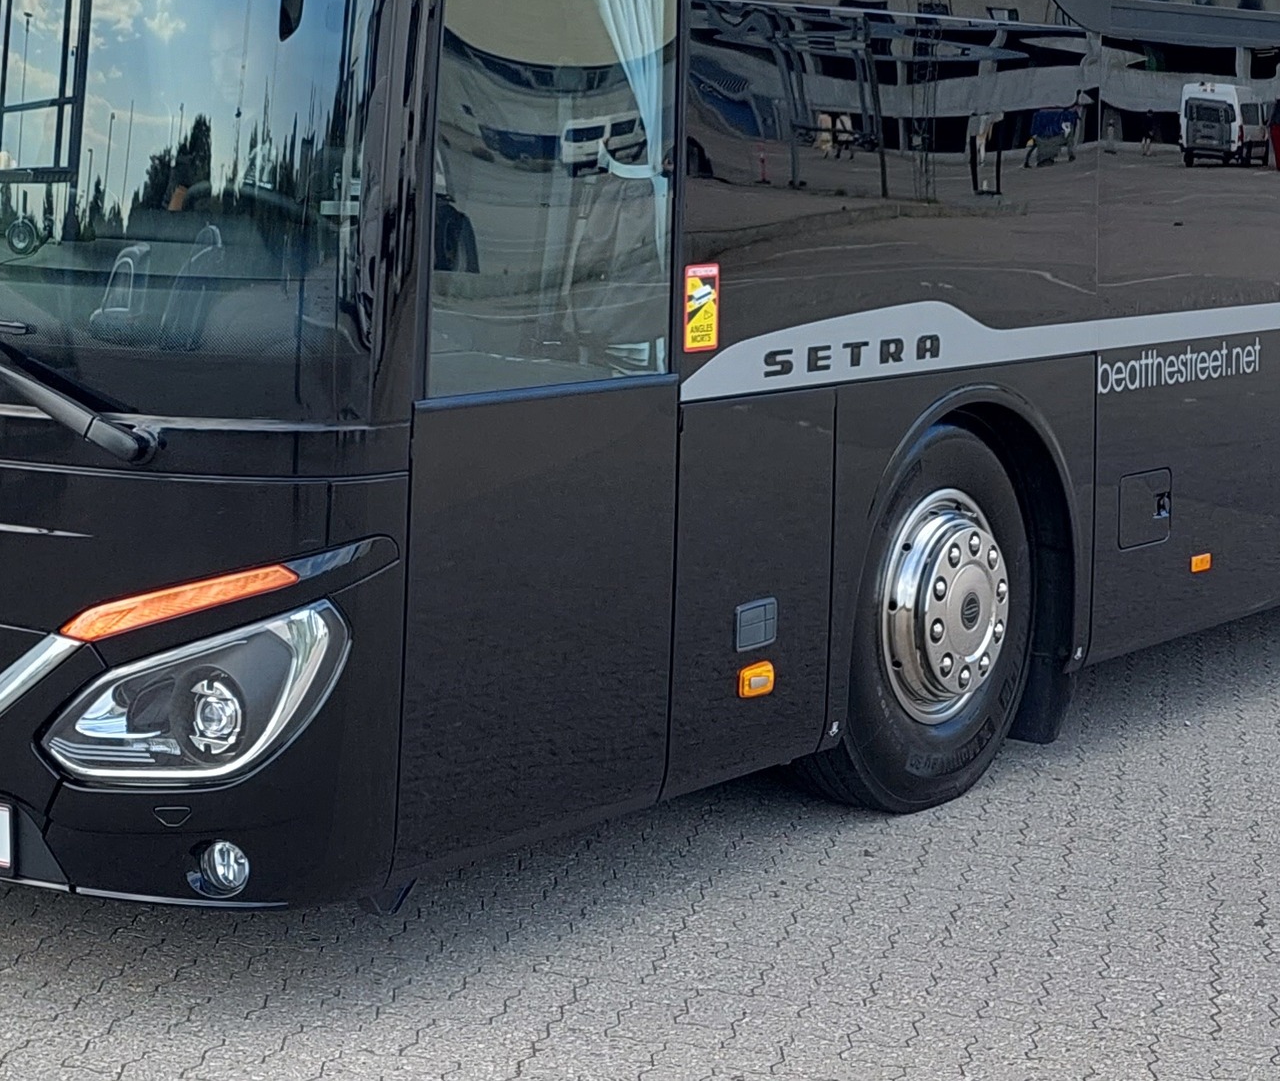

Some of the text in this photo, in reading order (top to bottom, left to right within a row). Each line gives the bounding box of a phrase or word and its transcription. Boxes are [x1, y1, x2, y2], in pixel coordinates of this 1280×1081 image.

[690, 323, 713, 334] ANGLES
[691, 333, 711, 343] MORTS
[763, 334, 940, 378] SETRA
[1097, 337, 1261, 394] beatthestreet.net
